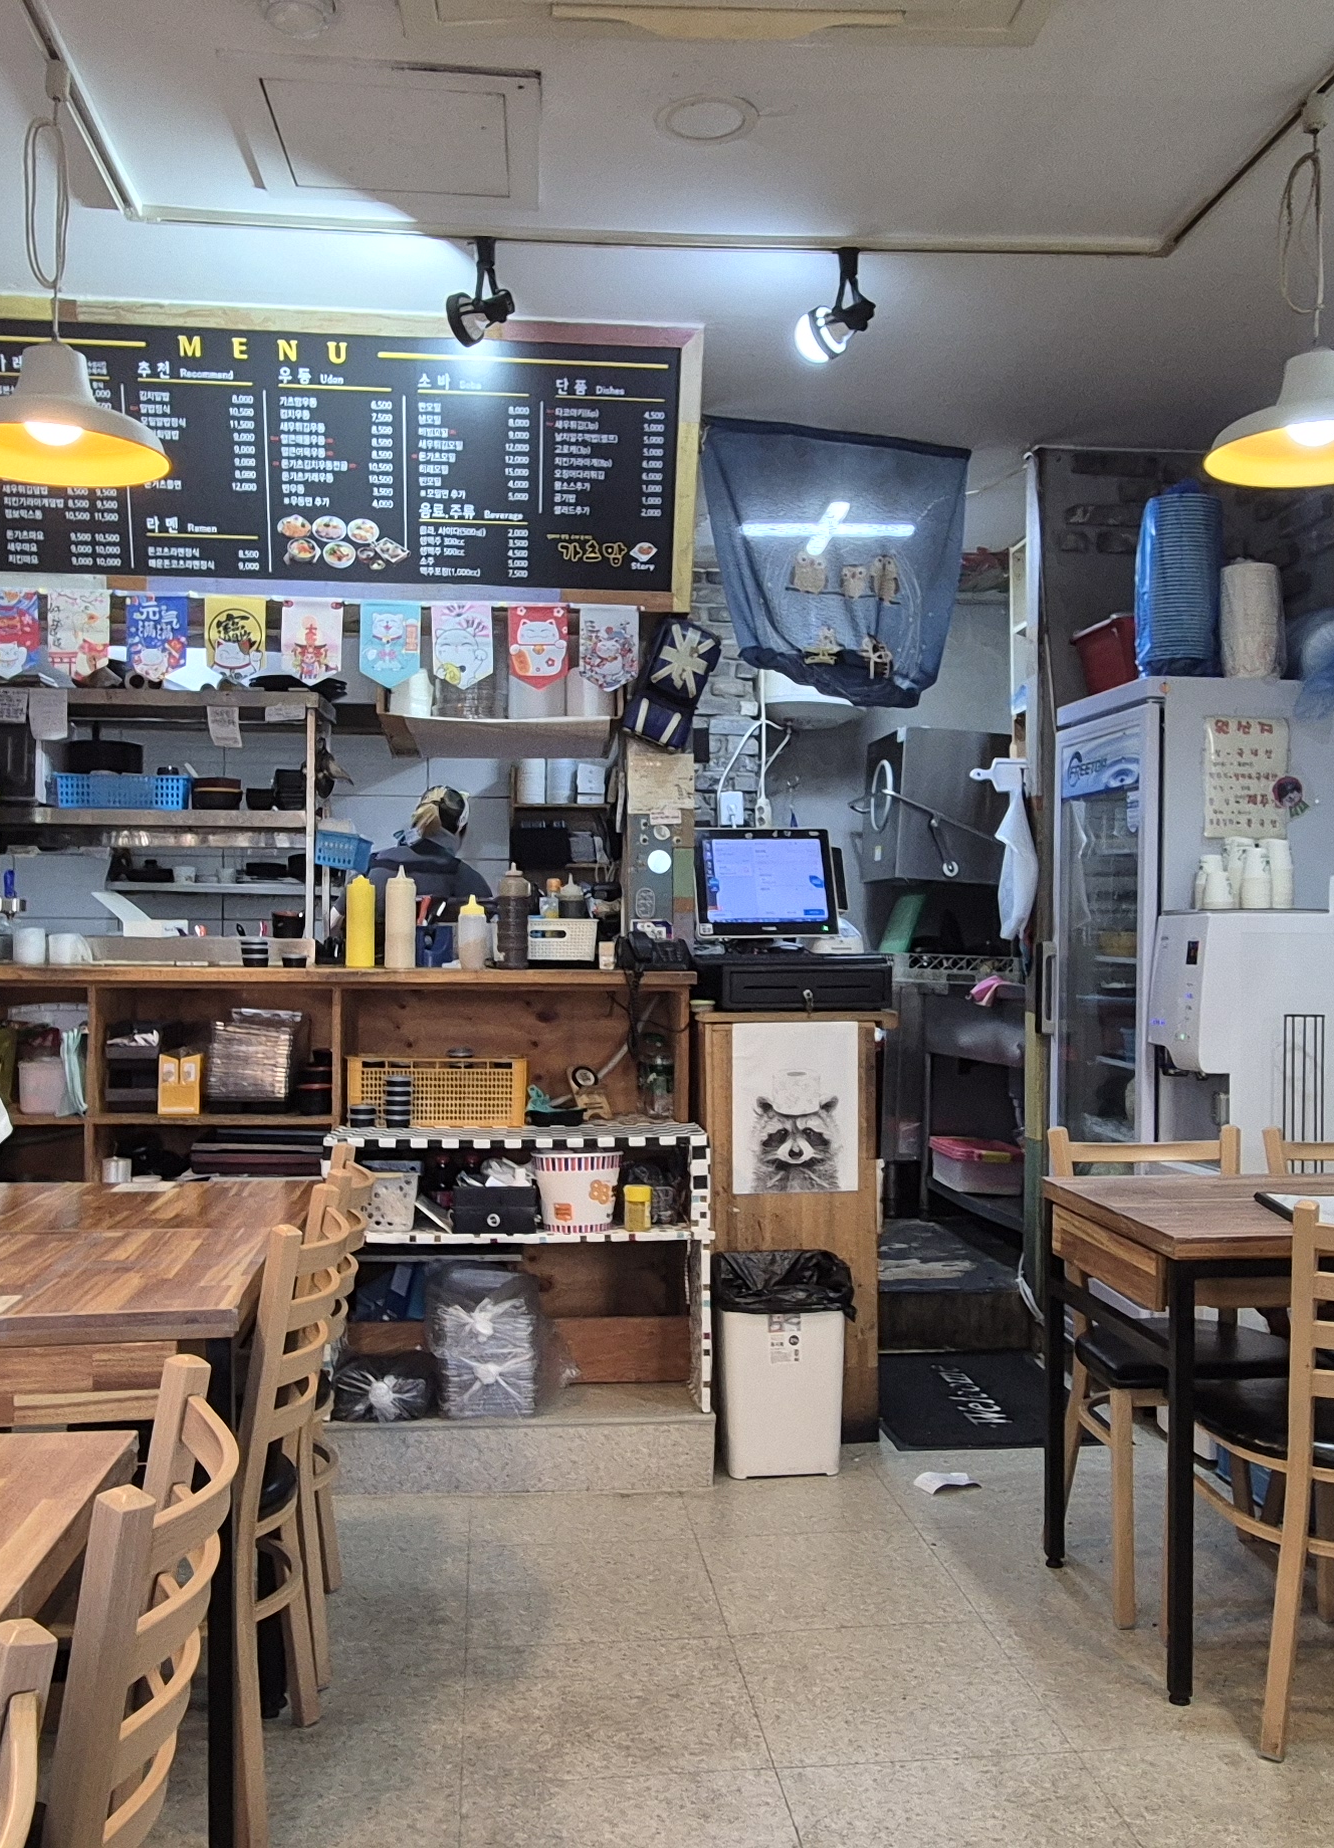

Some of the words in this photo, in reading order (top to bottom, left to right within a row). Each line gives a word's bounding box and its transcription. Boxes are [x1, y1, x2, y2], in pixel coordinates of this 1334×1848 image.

[177, 335, 347, 365] MENU
[137, 360, 170, 379] 추천
[180, 368, 233, 380] Recommend
[278, 366, 311, 384] 우동
[417, 373, 450, 390] 소바
[556, 378, 587, 395] 단품
[596, 386, 625, 395] Dishes
[146, 516, 178, 534] 라멘
[558, 540, 627, 567] 가츠맘
[631, 562, 655, 572] Story
